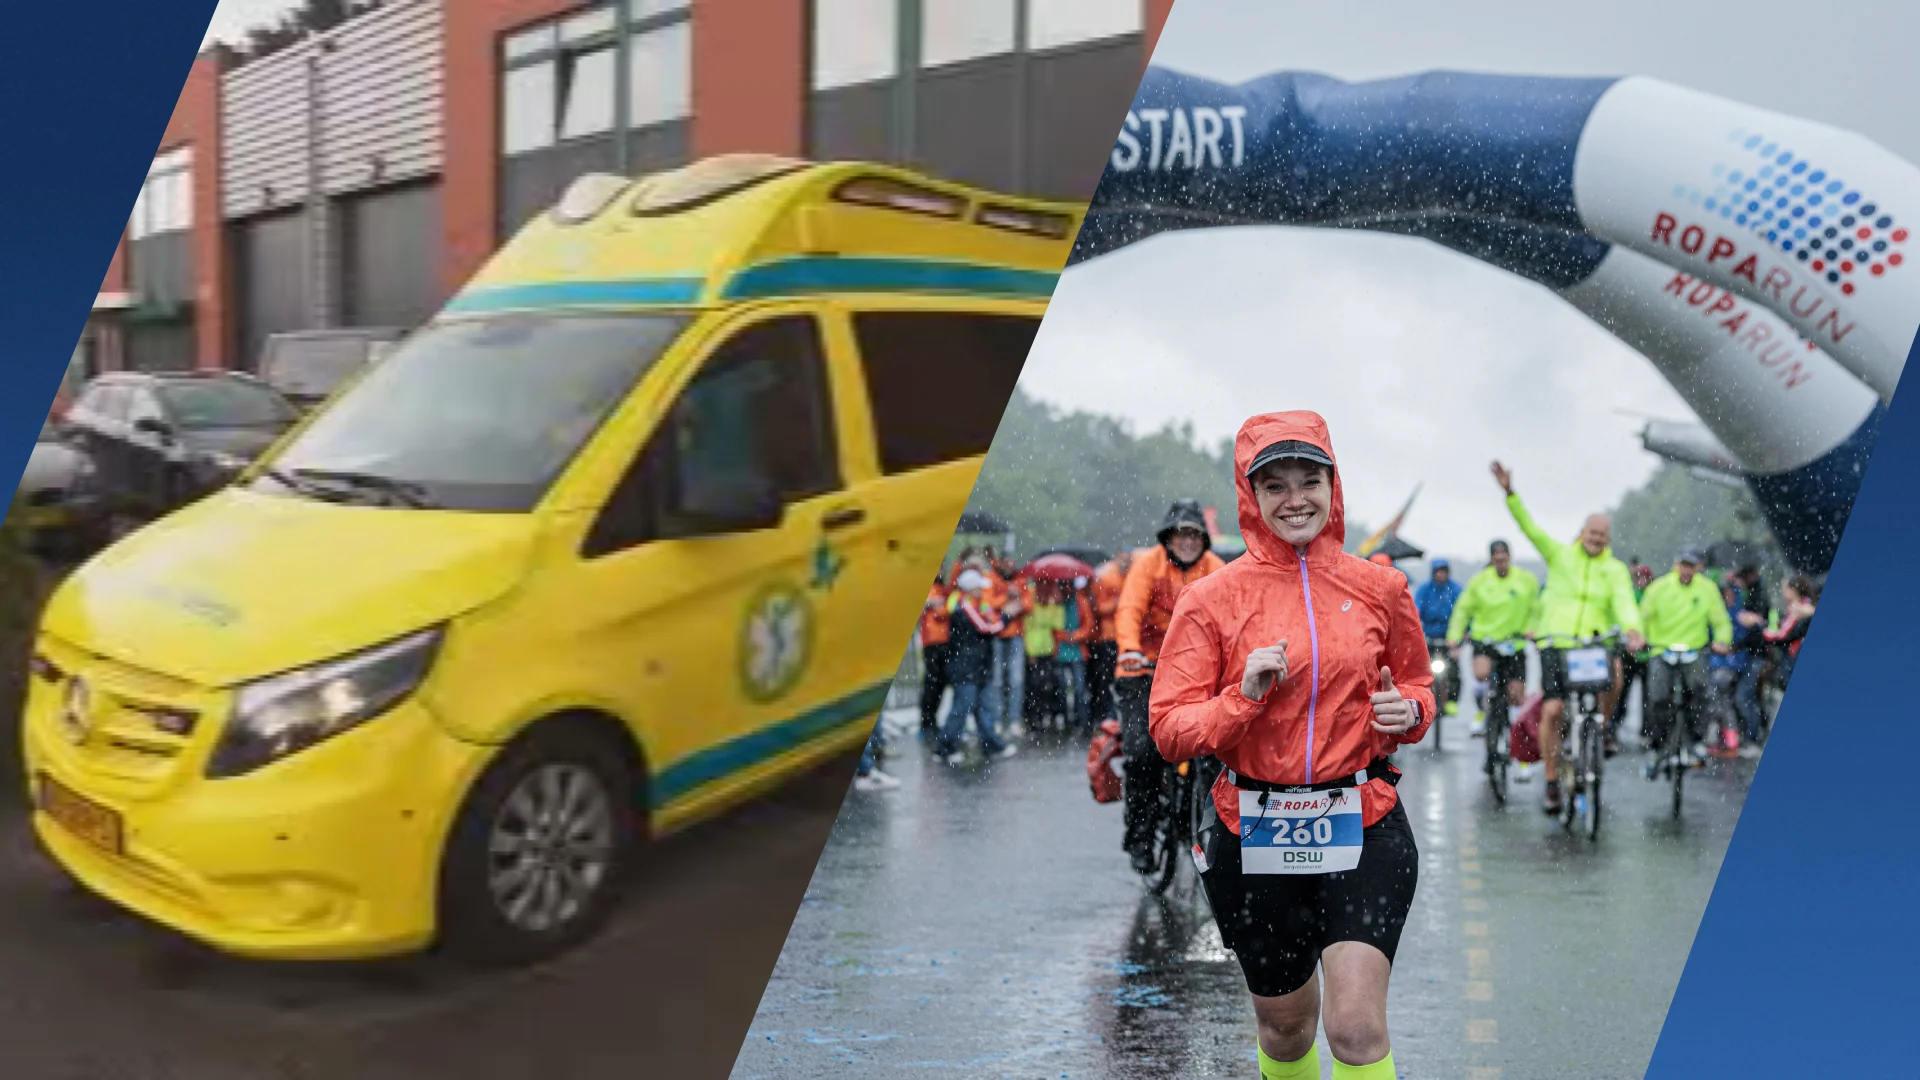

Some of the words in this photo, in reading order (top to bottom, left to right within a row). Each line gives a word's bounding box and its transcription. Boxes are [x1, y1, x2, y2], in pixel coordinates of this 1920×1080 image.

[1110, 105, 1247, 172] START
[1651, 211, 1855, 343] ROPARUN
[1664, 271, 1813, 390] ROPARUN
[1283, 796, 1349, 811] ROPARUN
[1271, 817, 1333, 845] 260
[1283, 851, 1323, 863] DSW
